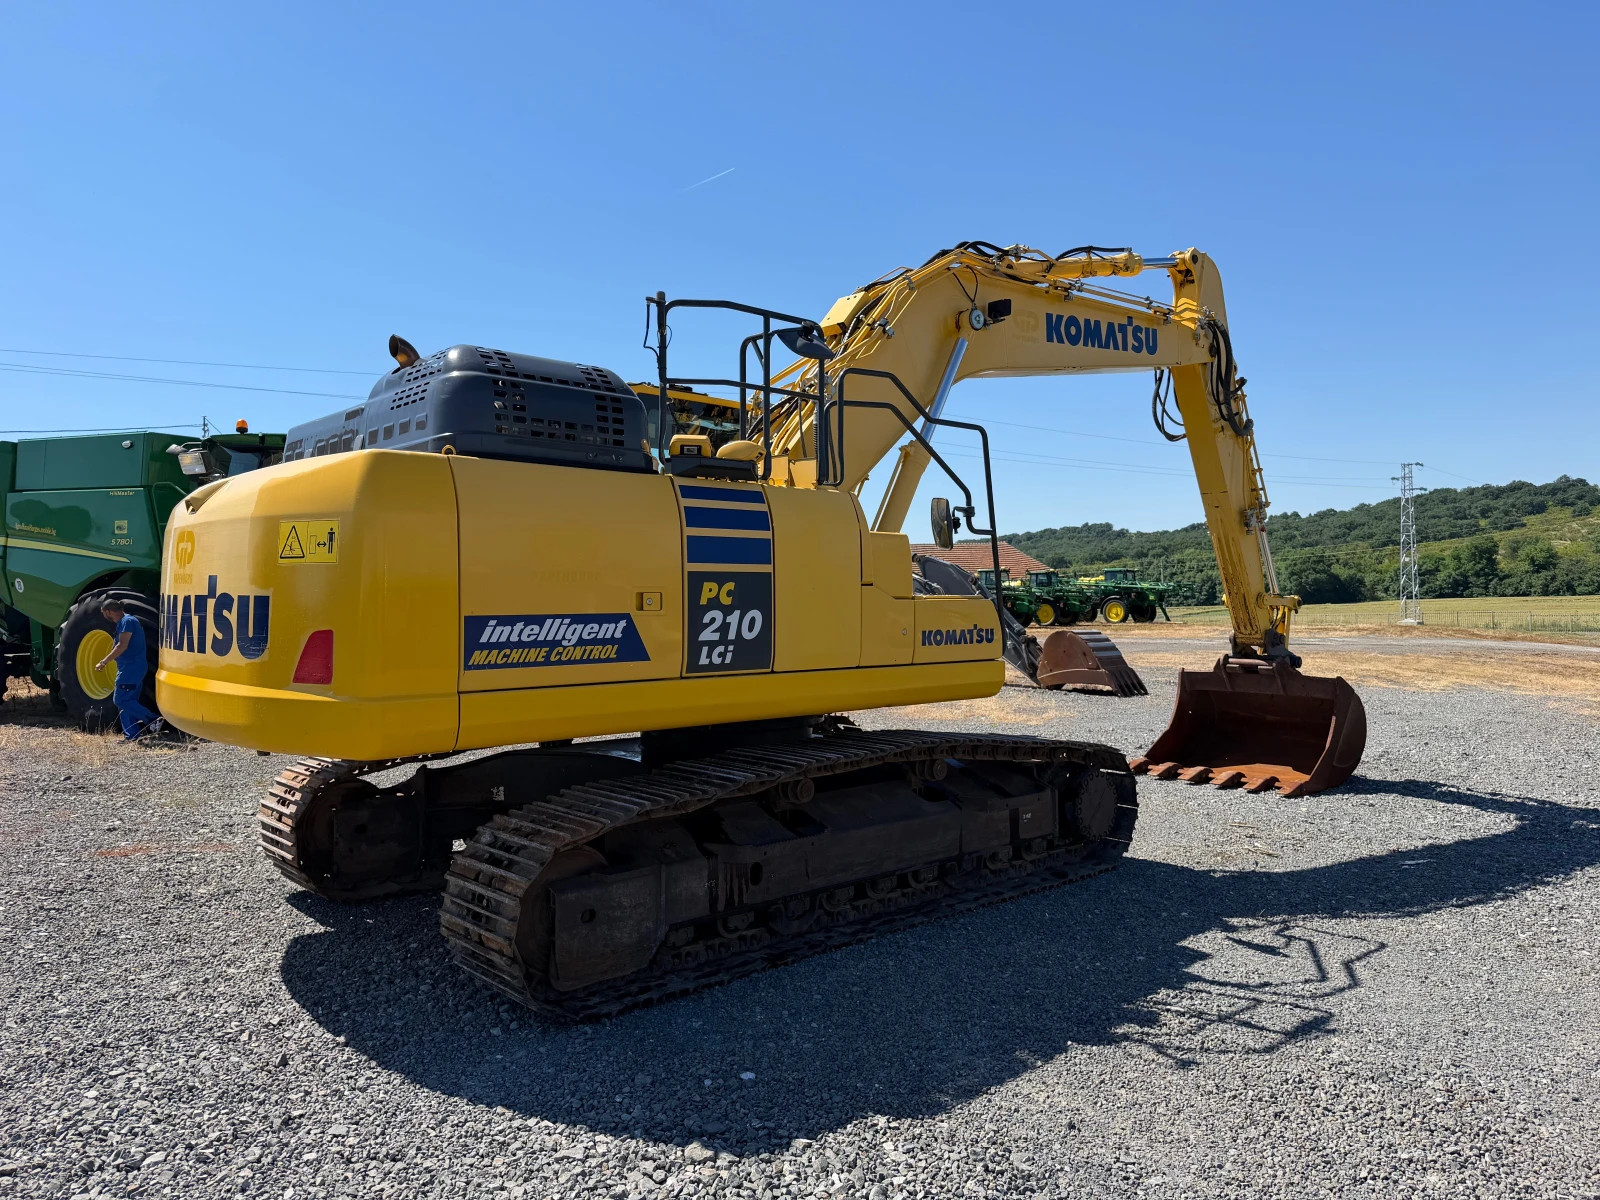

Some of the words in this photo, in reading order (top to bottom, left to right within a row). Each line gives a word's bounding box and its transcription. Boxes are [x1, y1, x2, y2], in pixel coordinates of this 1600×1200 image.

[1045, 312, 1158, 356] KOMATSU
[699, 581, 736, 606] PC
[160, 575, 270, 660] OMATSU
[697, 609, 763, 642] 210
[479, 618, 628, 647] intelligent
[921, 623, 995, 647] KOMATSU
[467, 646, 550, 666] MACHINE
[549, 644, 619, 662] CONTROL
[698, 645, 735, 666] LCi
